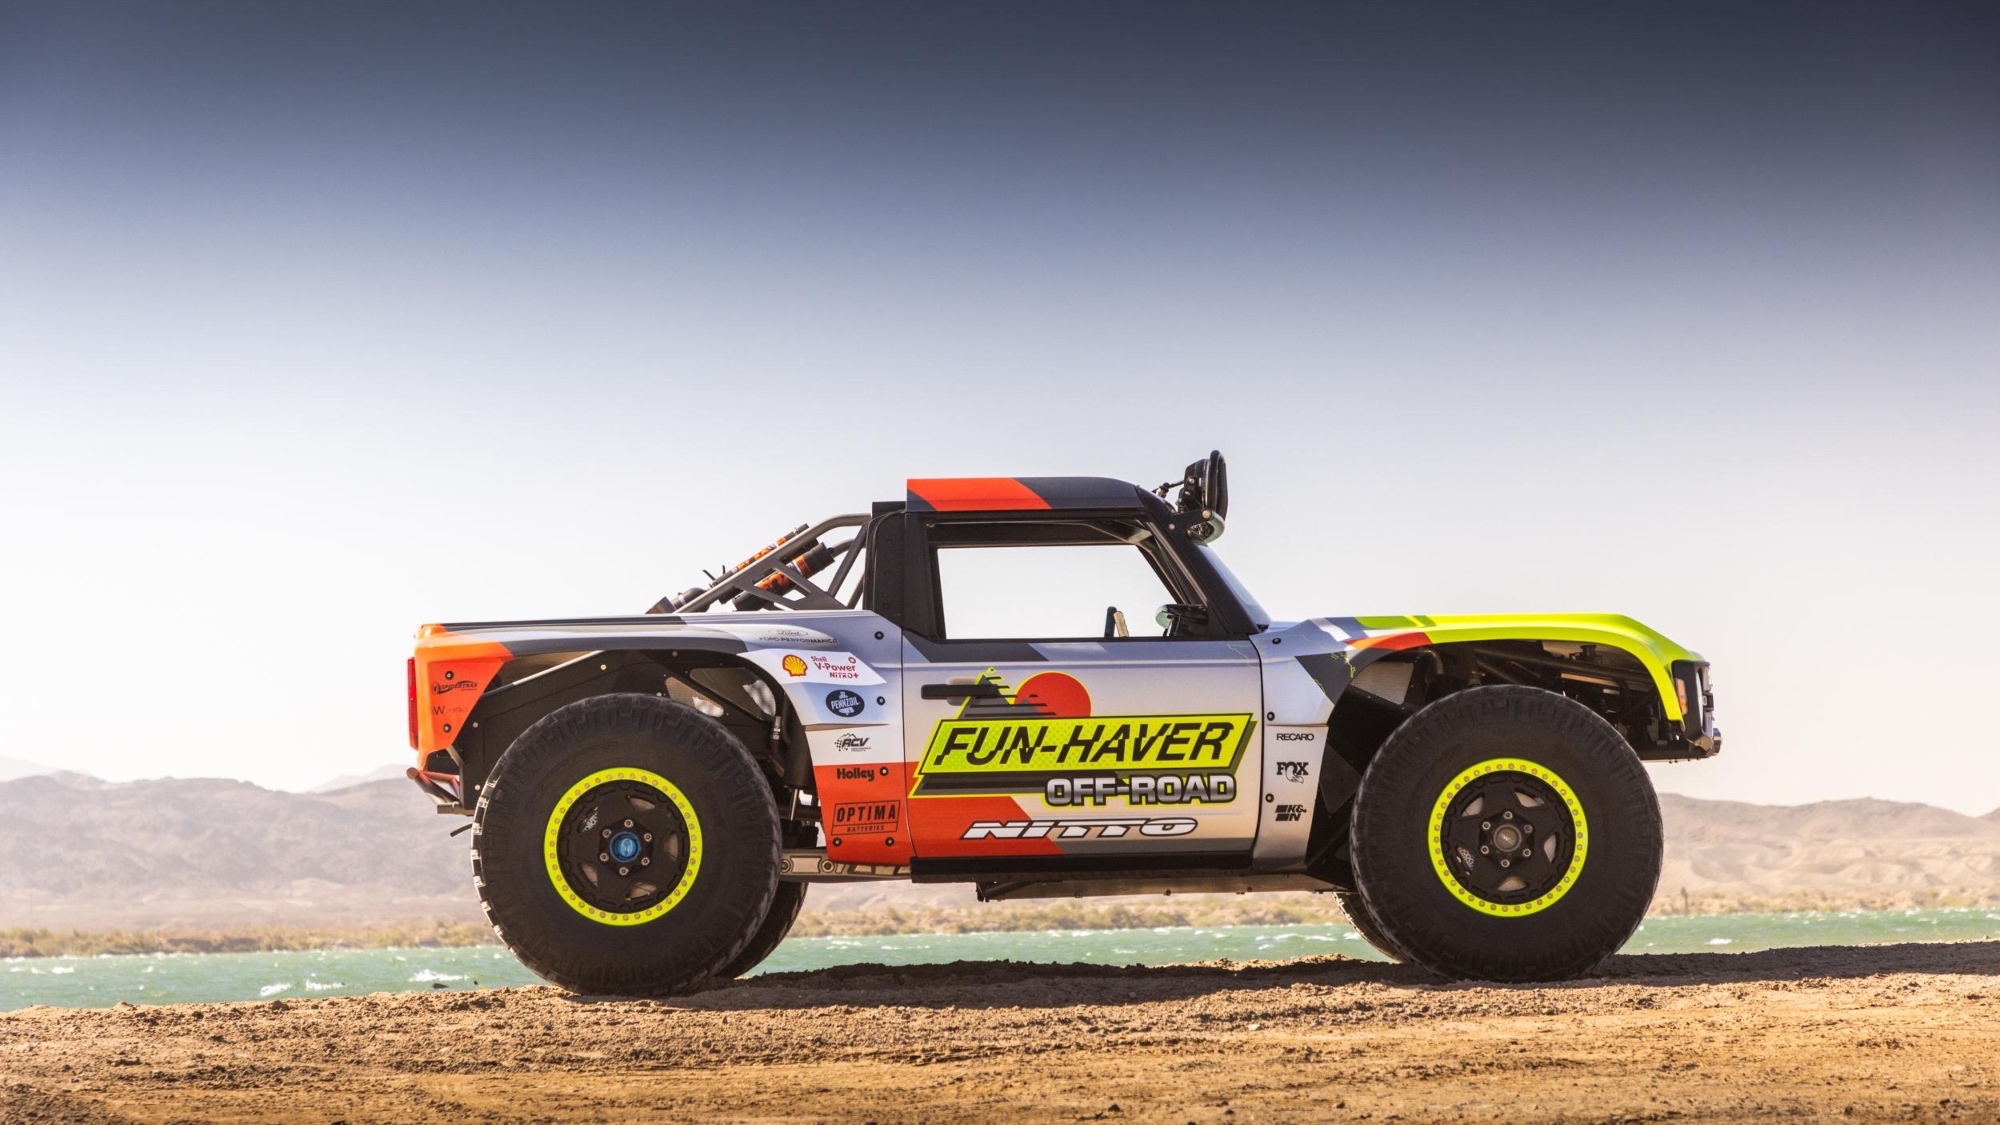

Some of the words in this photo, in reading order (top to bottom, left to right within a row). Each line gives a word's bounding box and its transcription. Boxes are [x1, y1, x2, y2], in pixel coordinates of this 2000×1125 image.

[814, 662, 856, 671] V-Power
[831, 697, 859, 710] PENNZOIL
[842, 737, 870, 747] RCV
[933, 721, 1235, 766] FUN-HAVER
[1276, 733, 1315, 741] RECARO
[836, 768, 875, 781] Holley
[1276, 761, 1309, 777] FOX
[1045, 774, 1237, 806] OFF-ROAD
[837, 805, 896, 822] OPTIMA
[847, 825, 885, 833] BATTERIES
